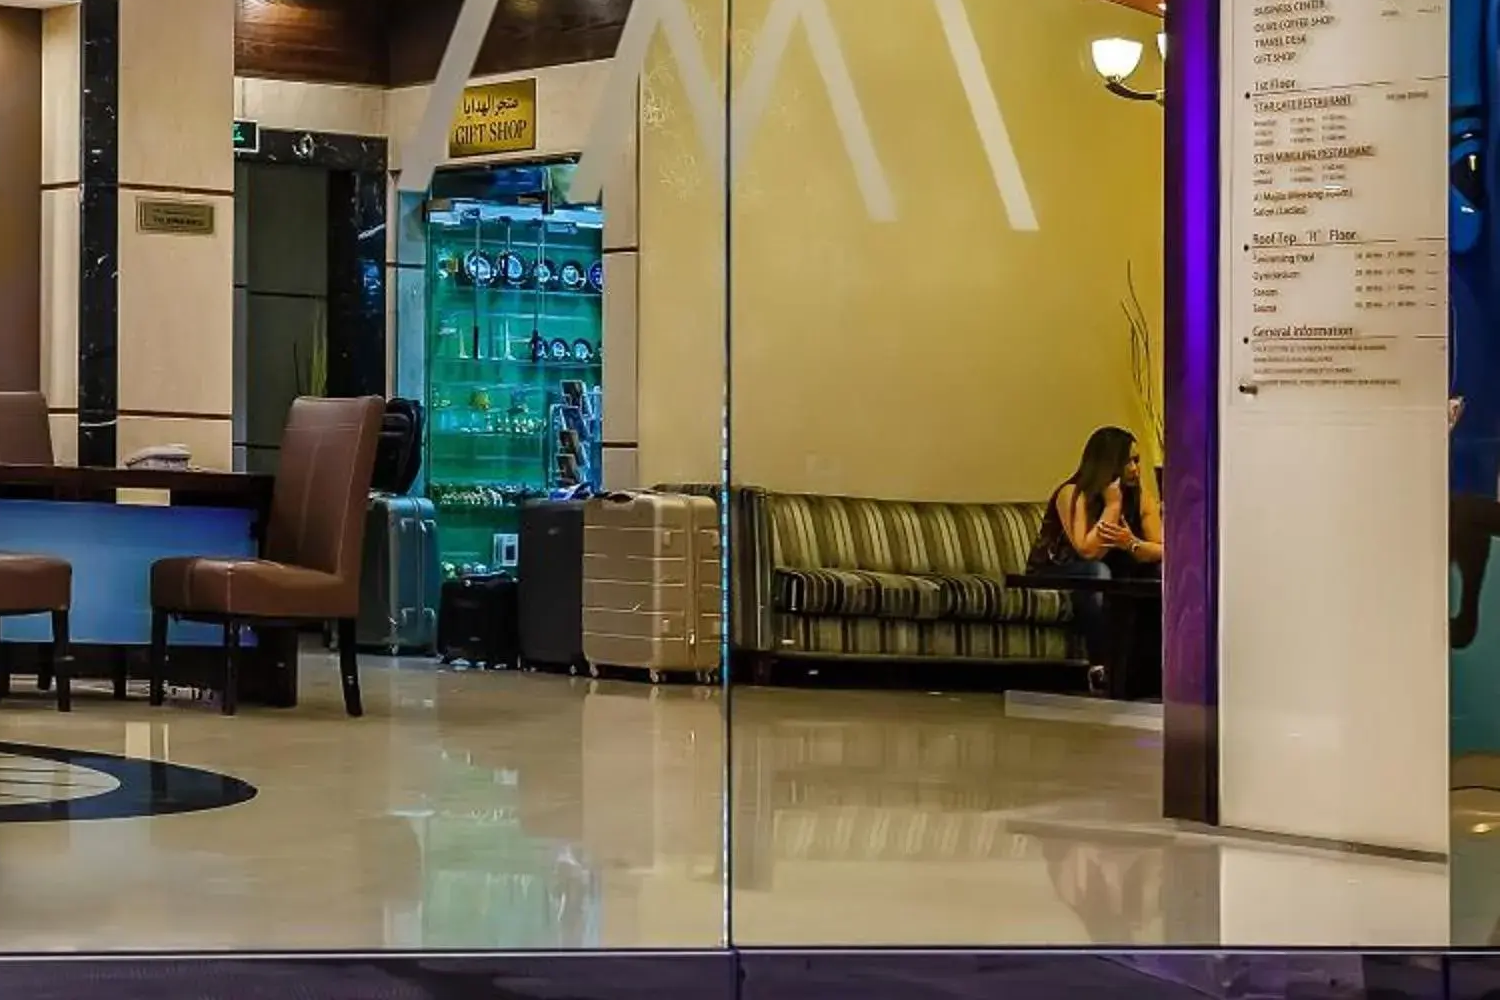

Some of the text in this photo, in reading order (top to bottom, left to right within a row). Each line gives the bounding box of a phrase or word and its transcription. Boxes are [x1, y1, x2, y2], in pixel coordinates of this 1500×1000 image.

[455, 119, 527, 145] GIFT SHOP
[1329, 228, 1357, 241] Floor
[1252, 323, 1354, 337] General Information
